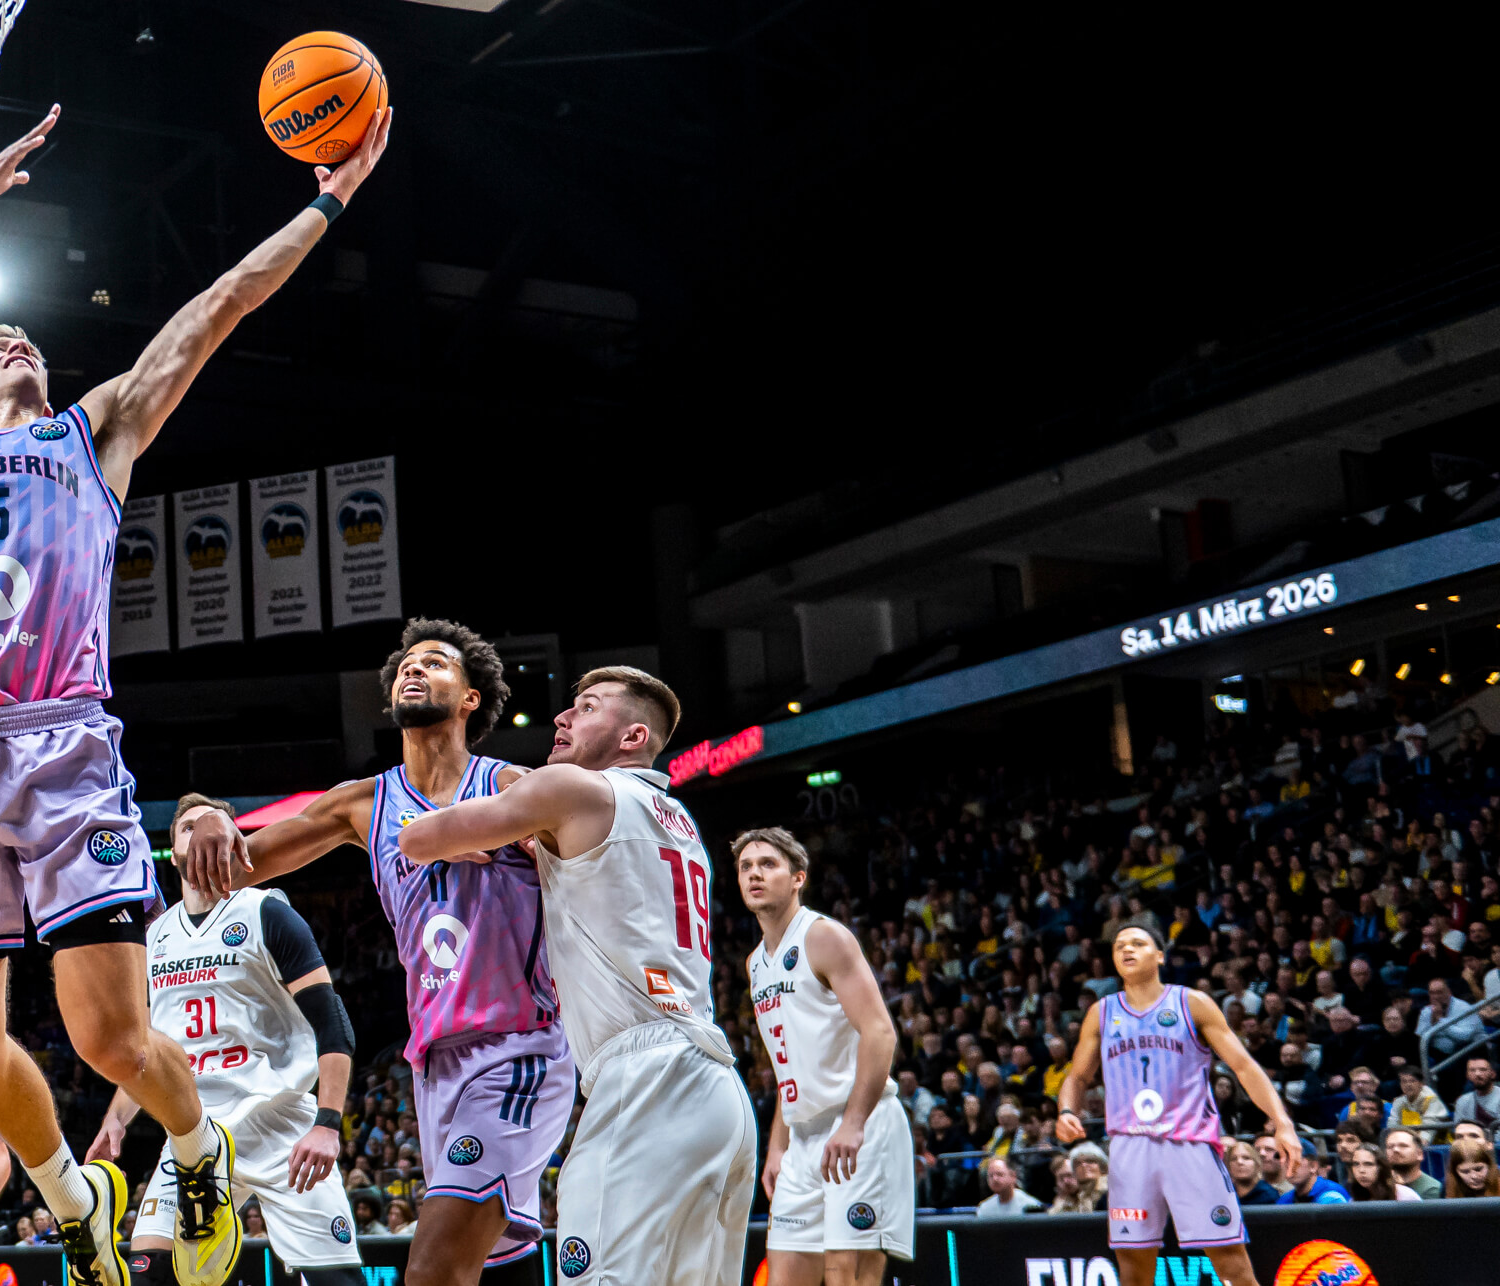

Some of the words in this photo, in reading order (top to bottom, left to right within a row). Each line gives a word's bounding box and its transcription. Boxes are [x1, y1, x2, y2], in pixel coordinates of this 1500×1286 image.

[273, 60, 294, 81] FIBA
[269, 94, 345, 142] Wilson
[1121, 627, 1160, 657] Sa.
[1159, 612, 1199, 647] 14.
[1198, 598, 1265, 636] März
[1266, 573, 1338, 617] 2026
[658, 846, 711, 962] 19
[152, 953, 239, 977] BASKETBALL
[152, 968, 218, 990] NYMBURK
[185, 996, 219, 1039] 31
[1108, 1038, 1136, 1061] ALBA
[1139, 1034, 1184, 1055] BERLIN
